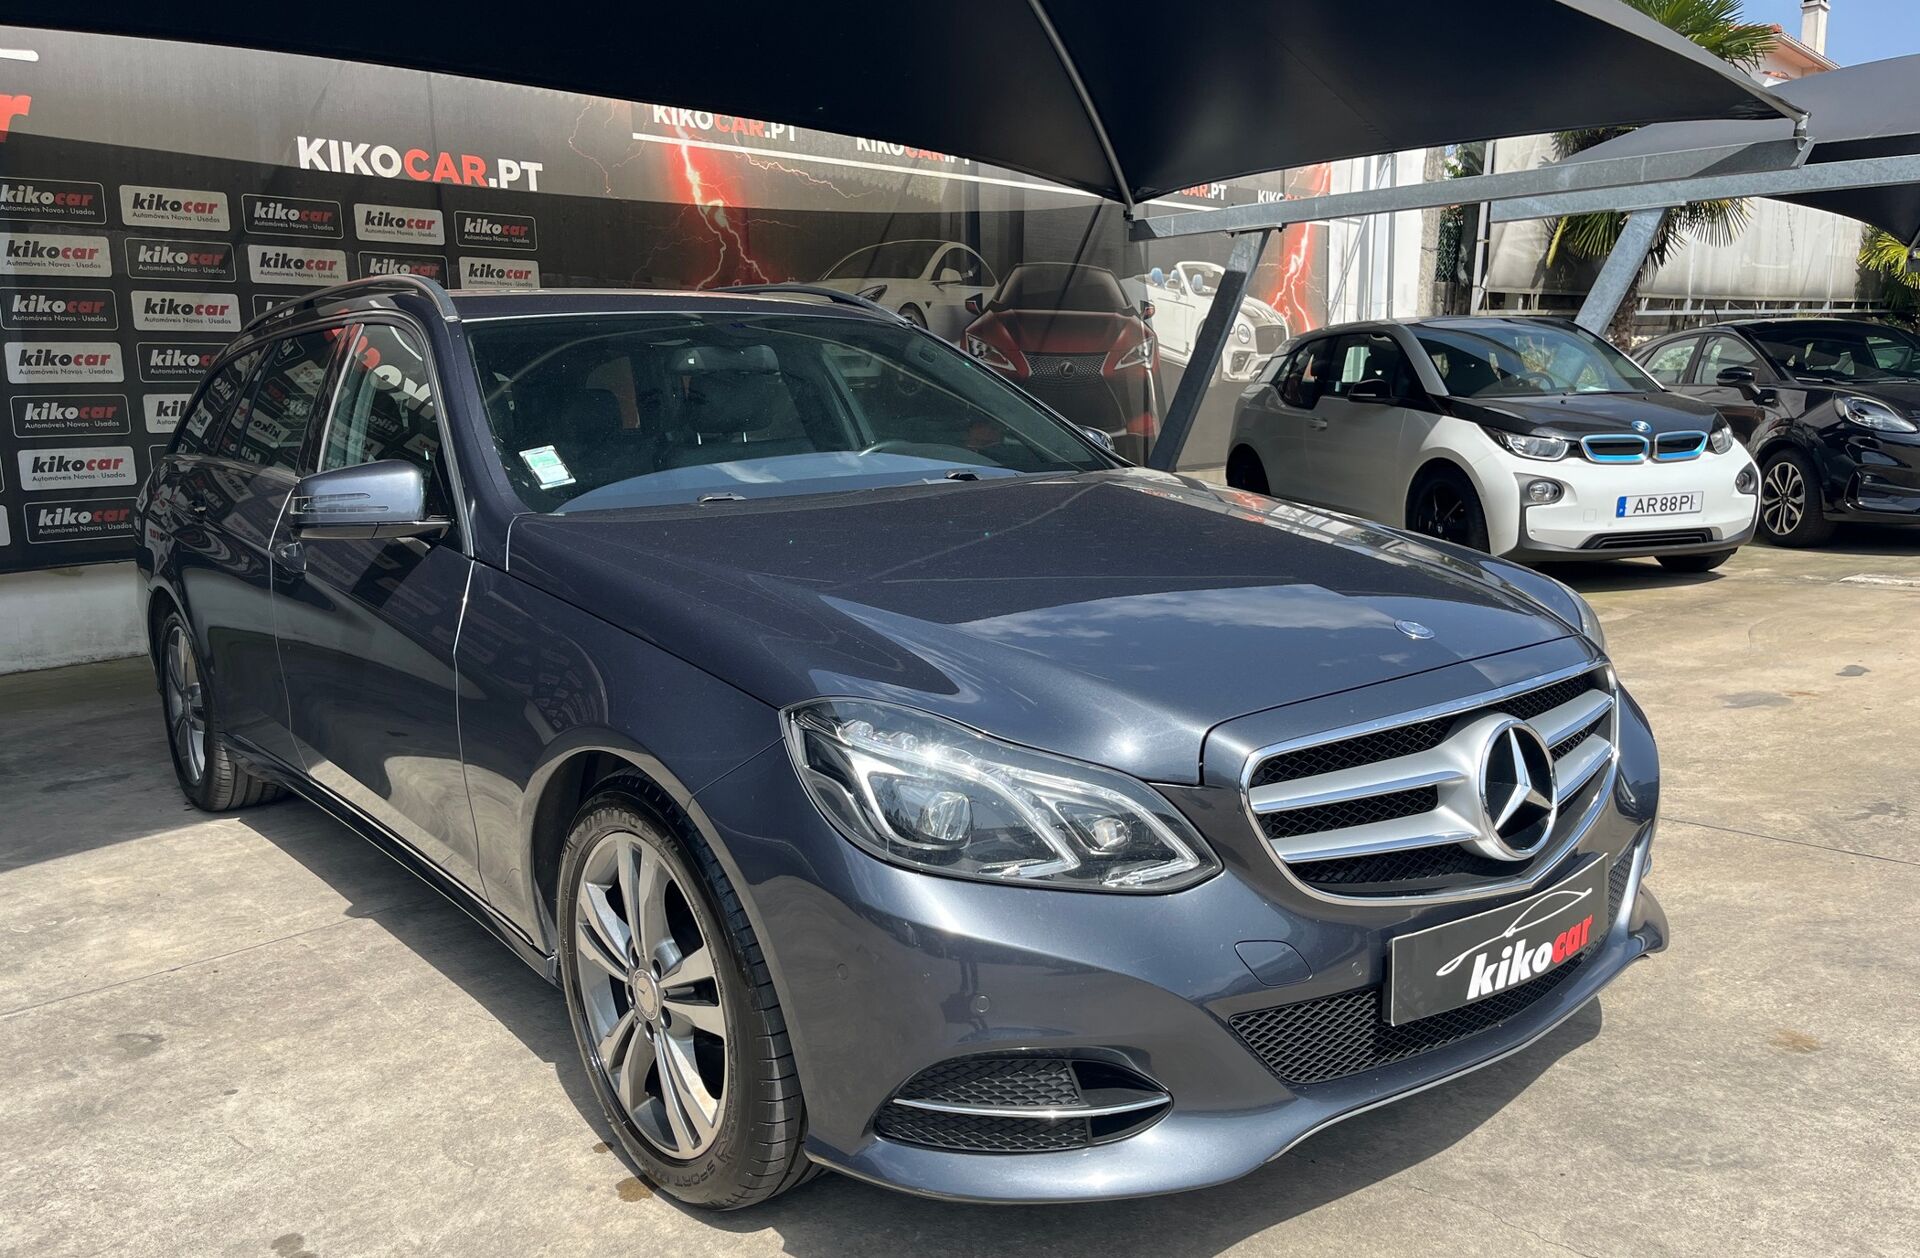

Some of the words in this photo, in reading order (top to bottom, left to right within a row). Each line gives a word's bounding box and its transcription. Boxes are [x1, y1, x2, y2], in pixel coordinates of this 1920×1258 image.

[652, 104, 795, 141] KIKOCAR.PT
[297, 136, 543, 192] KIKOCAR.PT
[0, 184, 93, 206] kikocar
[132, 193, 218, 214] kikocar
[0, 204, 40, 212] Automóveis
[42, 206, 65, 214] Novos
[70, 208, 95, 216] Usados
[254, 201, 333, 222] kikocar
[364, 210, 436, 230] kikocar
[464, 217, 529, 236] kikocar
[6, 239, 99, 260] kikocar
[138, 245, 224, 266] kikocar
[138, 264, 176, 272] Automóveis
[260, 252, 337, 271] kikocar
[369, 258, 440, 276] kikocar
[468, 263, 532, 280] kikocar
[12, 294, 105, 313] kikocar
[144, 298, 229, 316] kikocar
[18, 349, 111, 366] kikocar
[150, 349, 217, 366] kikoc
[24, 402, 117, 421] kikocar
[32, 456, 124, 474] kikocar
[1633, 494, 1694, 514] AR88PI
[38, 507, 130, 527] kikocar
[38, 527, 78, 535] Automóveis
[1466, 914, 1593, 1000] kikocar
